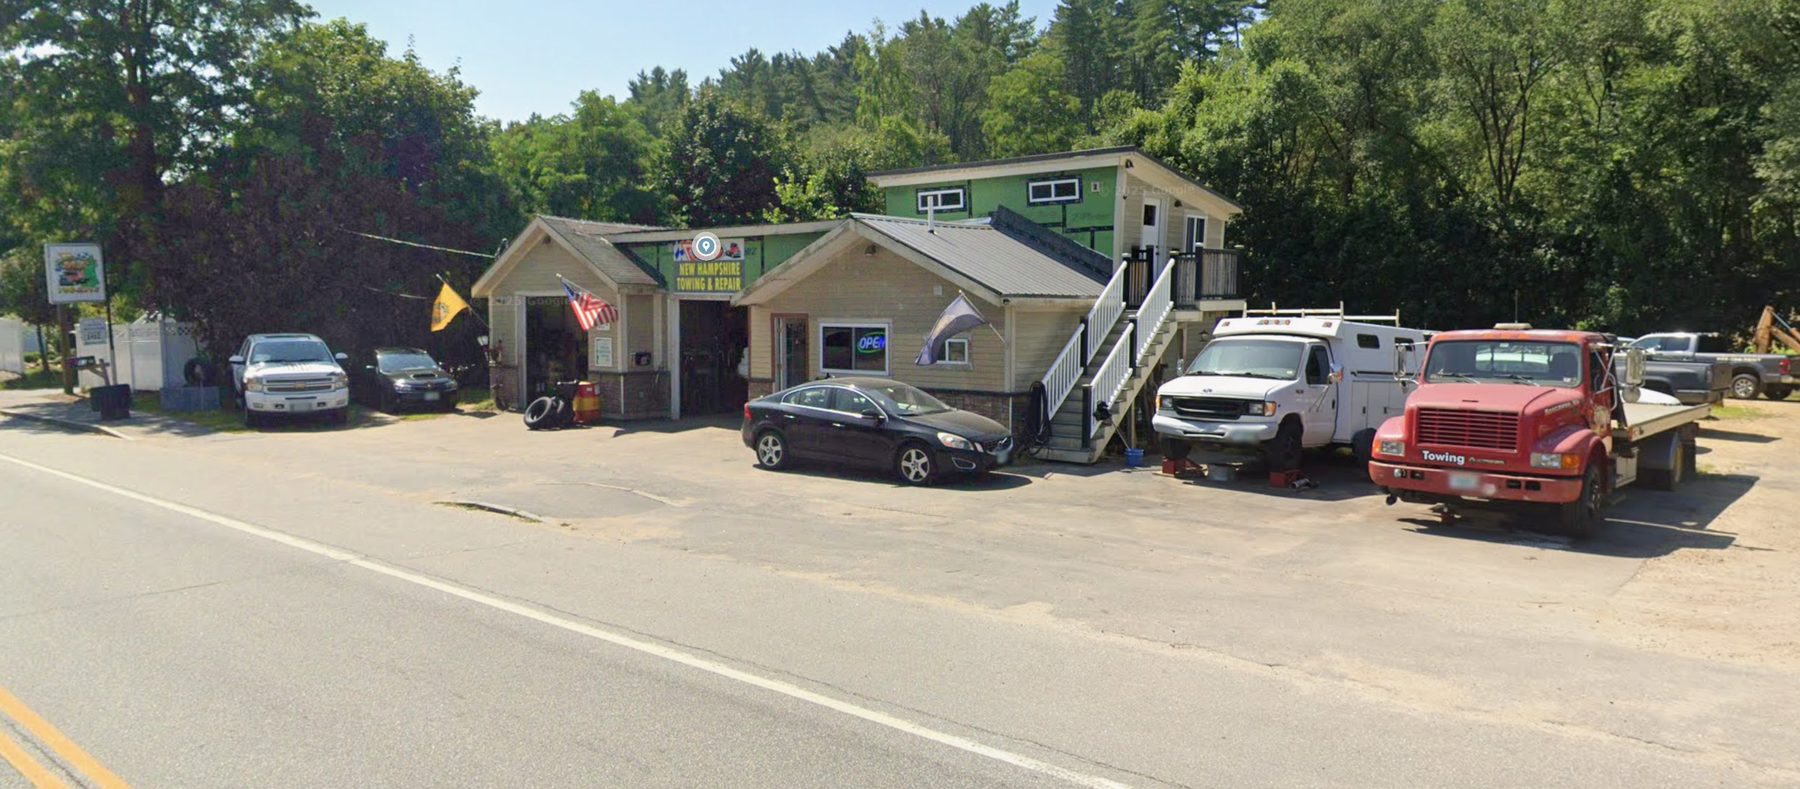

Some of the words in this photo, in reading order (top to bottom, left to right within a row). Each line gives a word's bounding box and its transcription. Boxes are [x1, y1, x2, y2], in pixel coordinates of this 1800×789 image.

[679, 262, 696, 276] NEW
[698, 262, 741, 276] HAMPSHIRE
[677, 277, 706, 291] TOWING
[708, 277, 713, 291] &
[715, 277, 742, 291] REPAIR
[1422, 450, 1465, 465] Towing
